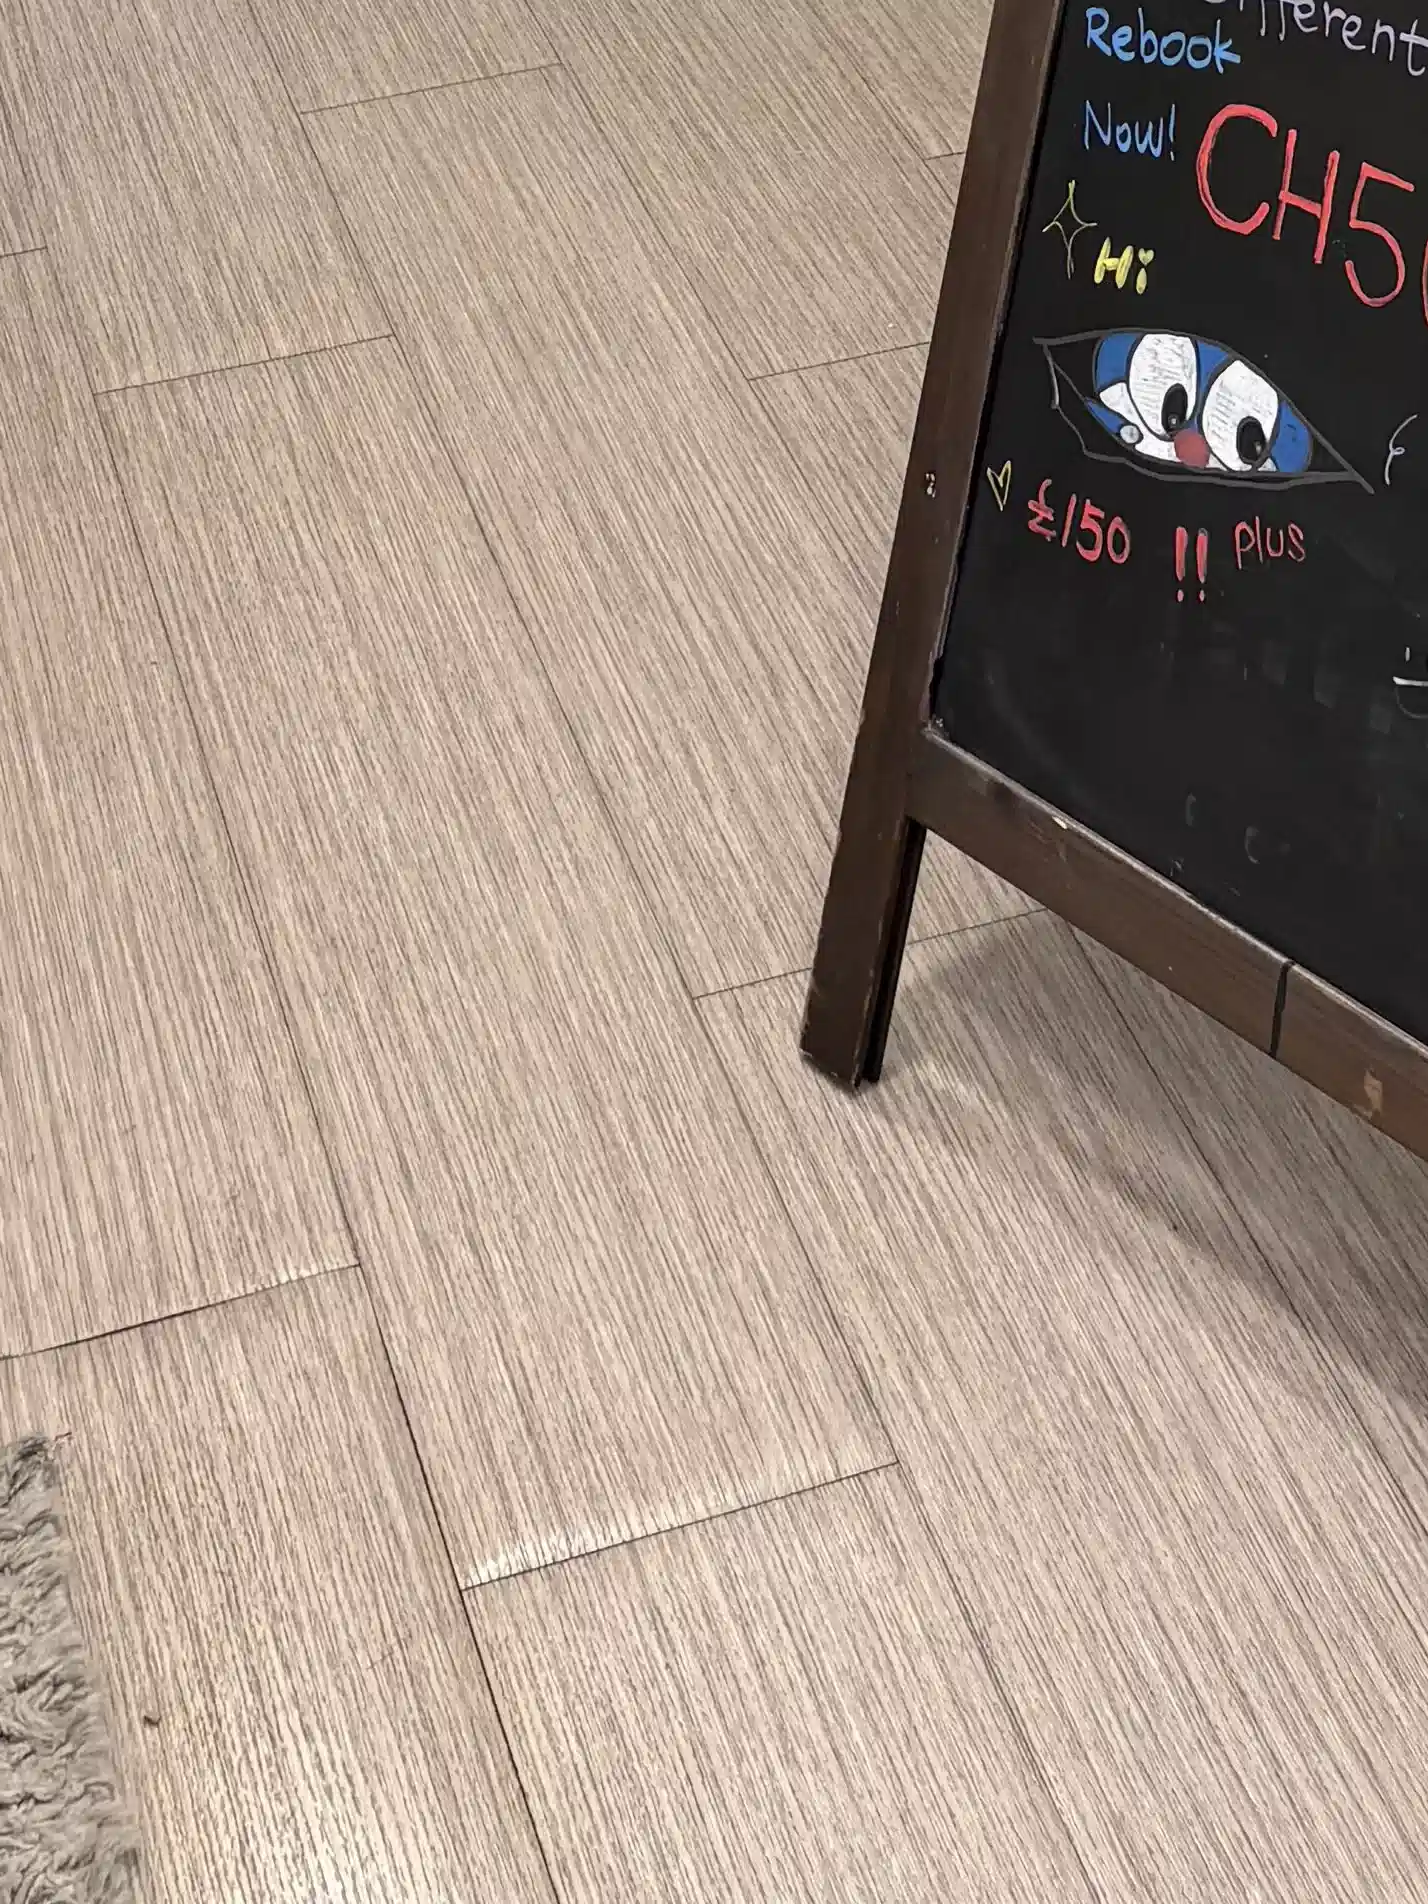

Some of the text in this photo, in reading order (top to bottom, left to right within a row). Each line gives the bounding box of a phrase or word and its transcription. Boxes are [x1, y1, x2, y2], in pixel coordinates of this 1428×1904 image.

[1085, 6, 1242, 75] Rebook
[1082, 99, 1178, 161] Now!
[1093, 236, 1156, 296] Hi
[1027, 478, 1132, 566] £150
